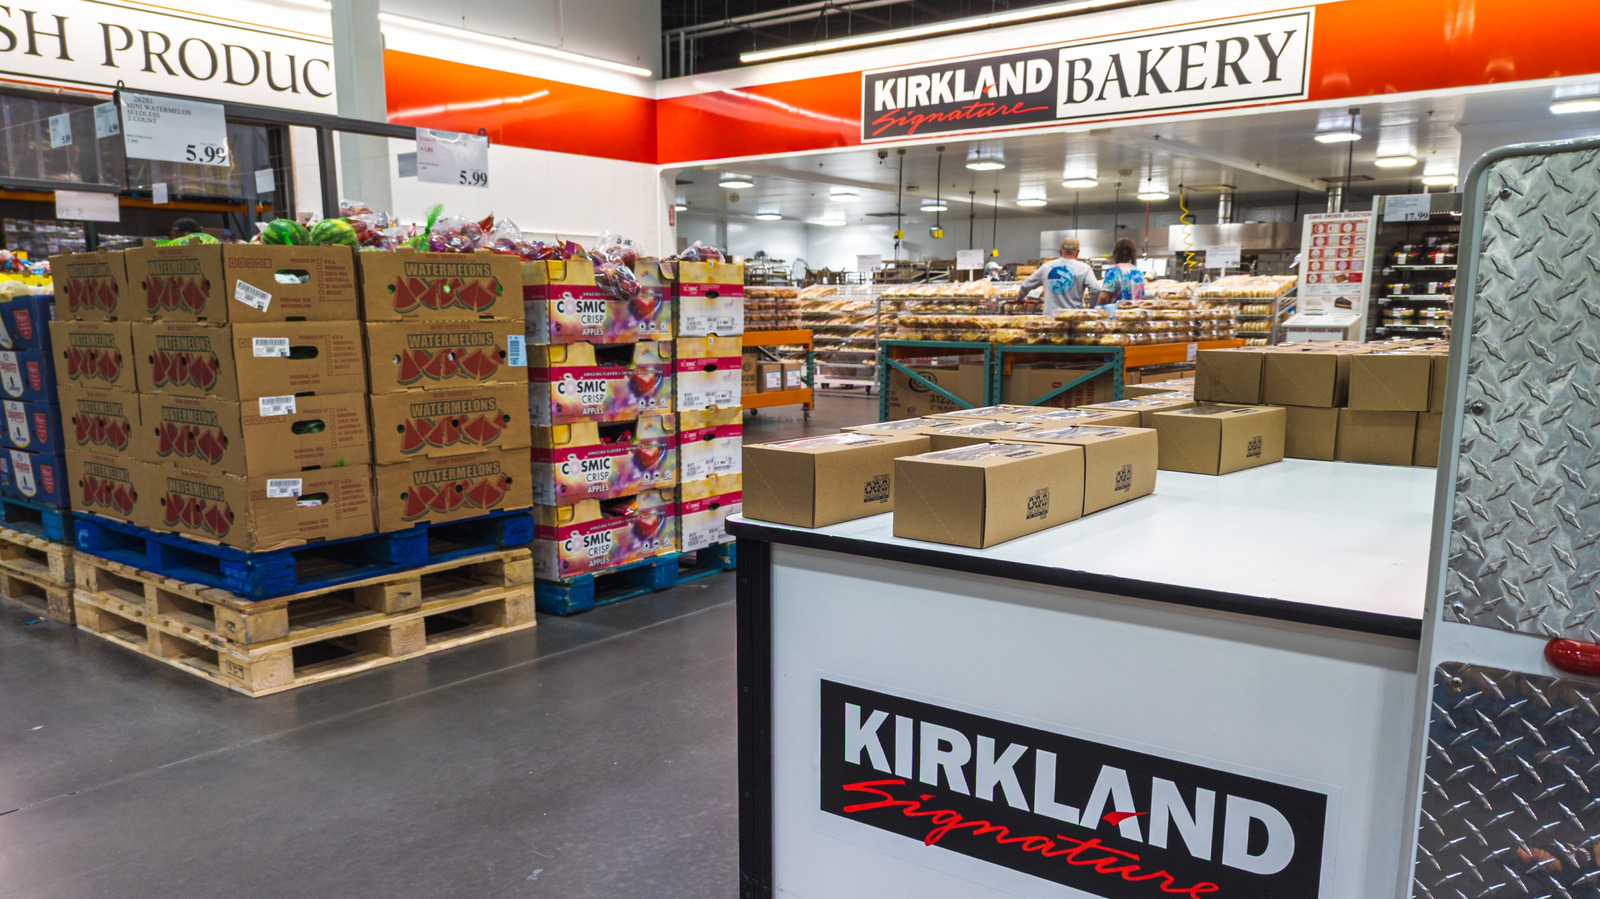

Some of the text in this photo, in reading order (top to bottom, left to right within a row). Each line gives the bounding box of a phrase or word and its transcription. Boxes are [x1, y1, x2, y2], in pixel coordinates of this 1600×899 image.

[98, 22, 332, 98] PRODUC
[1064, 30, 1297, 104] BAKERY
[874, 58, 1053, 112] KIRKLAND
[127, 102, 192, 116] MINI WATERMELON
[128, 110, 160, 118] SEEDLESS
[133, 116, 156, 124] COUNT
[872, 101, 1048, 136] Signature
[186, 144, 227, 164] 5.99
[460, 170, 488, 187] 5.99
[1405, 212, 1428, 221] 17.99
[404, 262, 492, 277] WATERMELONS
[581, 315, 604, 324] CRISP
[582, 327, 604, 336] APPLES
[407, 332, 494, 349] WATERMELONS
[582, 394, 604, 404] CRISP
[410, 396, 496, 418] WATERMELONS
[582, 407, 604, 416] APPLES
[413, 460, 500, 485] WATERMELONS
[586, 472, 609, 483] CRISP
[587, 484, 610, 494] APPLES
[588, 545, 610, 557] CRISP
[589, 556, 610, 568] APPLES
[844, 702, 1295, 876] KIRKLAND
[843, 779, 1219, 899] Signature
